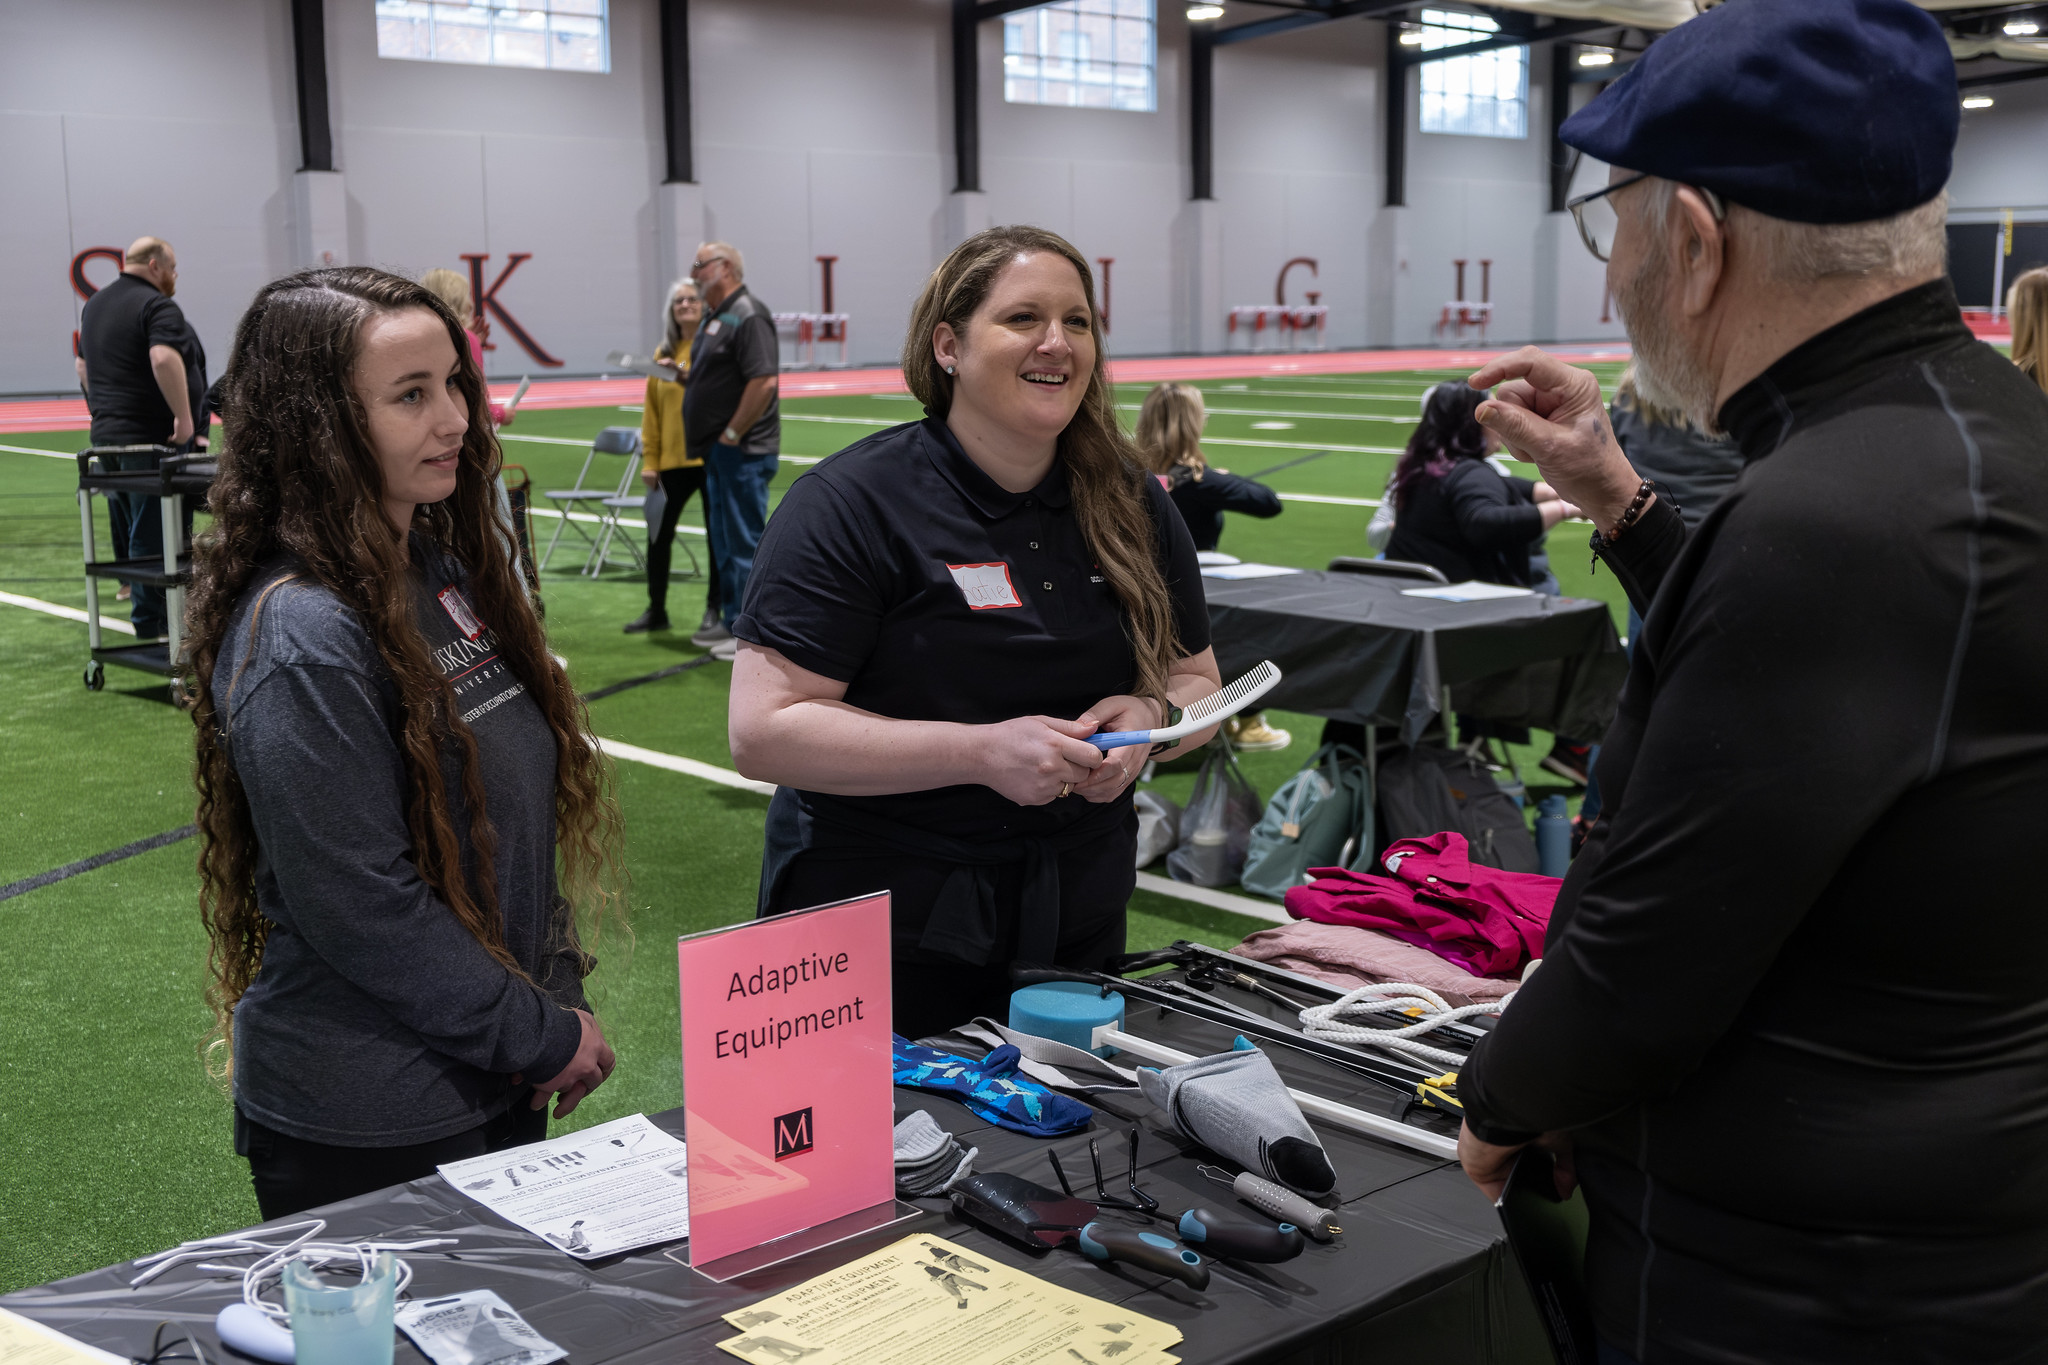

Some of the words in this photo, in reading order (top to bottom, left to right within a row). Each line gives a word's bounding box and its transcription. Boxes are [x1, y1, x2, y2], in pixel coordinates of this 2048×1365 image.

[459, 253, 565, 367] K
[727, 952, 848, 1001] Adaptive
[716, 997, 863, 1058] Equipment
[777, 1113, 812, 1154] M
[782, 1301, 837, 1327] ADAPTIVE
[835, 1275, 896, 1304] EQUIPMENT
[785, 1278, 840, 1303] ADAPTIVE
[839, 1255, 900, 1281] EQUIPMENT
